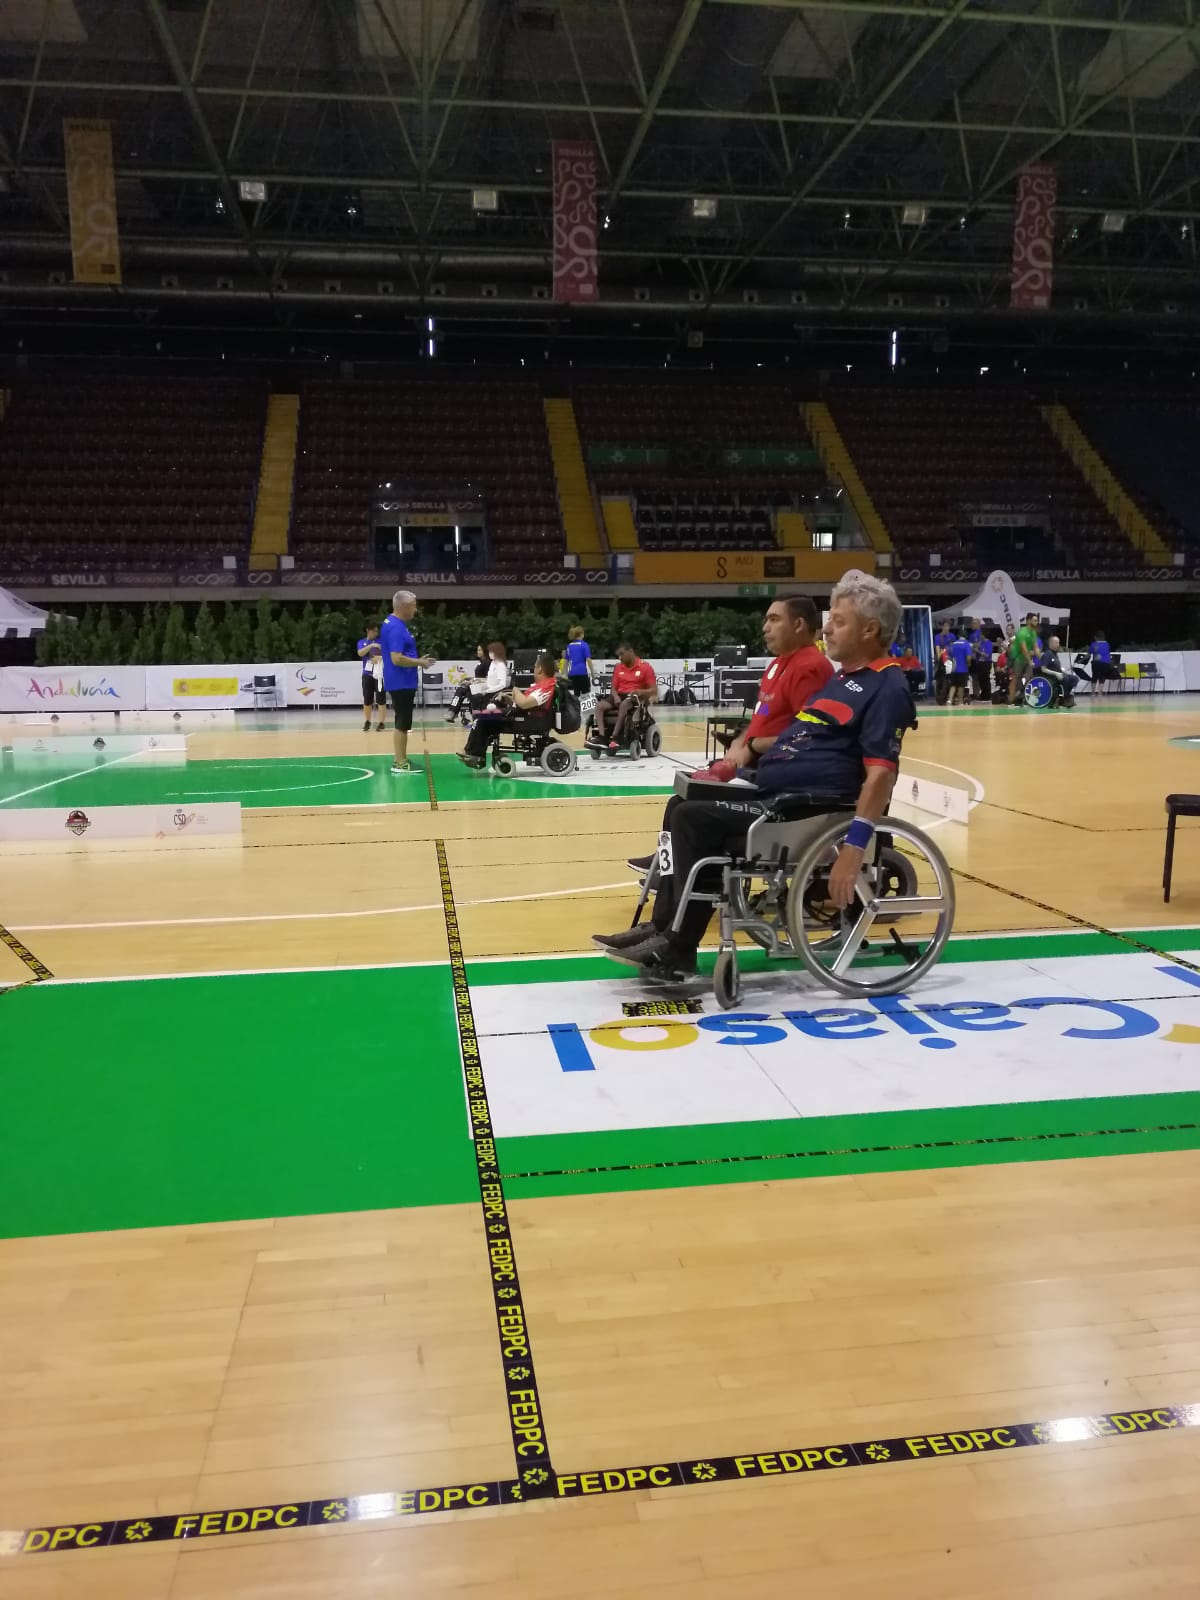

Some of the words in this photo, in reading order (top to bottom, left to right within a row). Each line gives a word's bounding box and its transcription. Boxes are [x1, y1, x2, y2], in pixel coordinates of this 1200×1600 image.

[411, 502, 446, 510] SEVILLA
[51, 574, 107, 586] SEVILLA
[406, 573, 457, 584] SEVILLA
[1036, 569, 1081, 580] SEVILLA
[26, 678, 120, 698] Andalucía
[844, 680, 864, 693] ESP
[581, 698, 598, 711] 208
[660, 849, 672, 872] 3
[547, 994, 1161, 1072] Cajasol
[462, 1038, 478, 1057] FEDPC
[466, 1067, 482, 1088] FEDPC
[470, 1099, 490, 1126] FEDPC
[475, 1137, 496, 1169] FEDPC
[481, 1183, 505, 1220] FEDPC
[489, 1238, 516, 1282] FEDPC
[498, 1305, 528, 1359] FEDPC
[510, 1389, 544, 1457] FEDPC
[173, 1505, 300, 1538] FEDPC
[394, 1485, 489, 1515] EDPC
[556, 1465, 673, 1496] FEDPC
[734, 1447, 849, 1477] FEDPC
[905, 1428, 1017, 1458] FEDPC
[1096, 1409, 1178, 1436] EDPC
